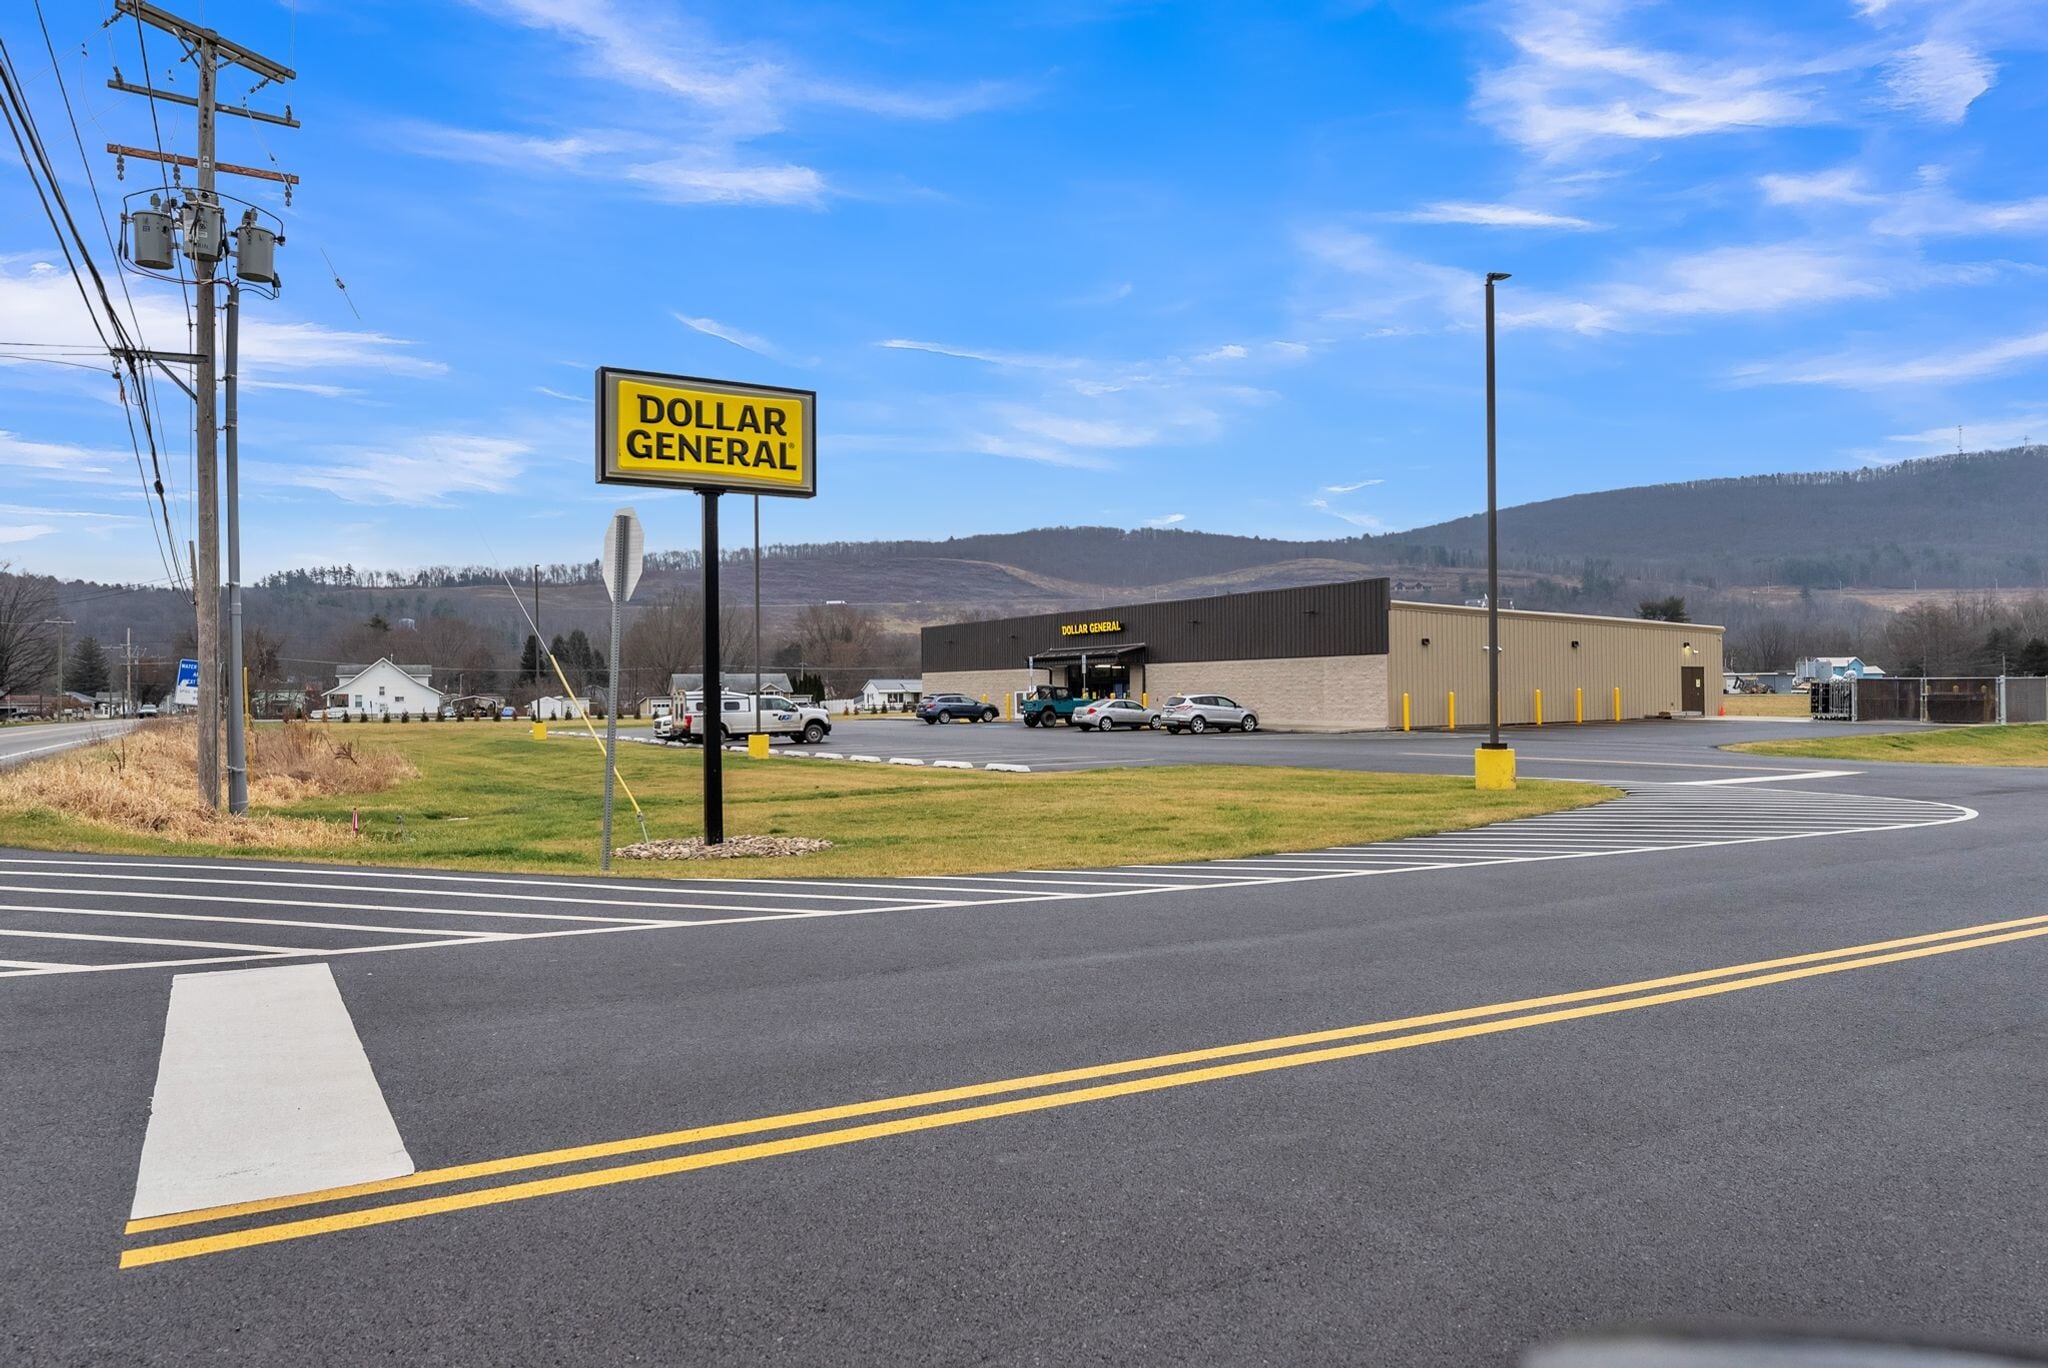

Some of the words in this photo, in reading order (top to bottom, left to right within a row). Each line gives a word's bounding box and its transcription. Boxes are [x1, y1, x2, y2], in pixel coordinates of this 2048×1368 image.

[637, 393, 787, 436] DOLLAR
[626, 429, 797, 471] GENERAL
[1061, 623, 1088, 636] DOLLAR
[1089, 620, 1122, 634] GENERAL
